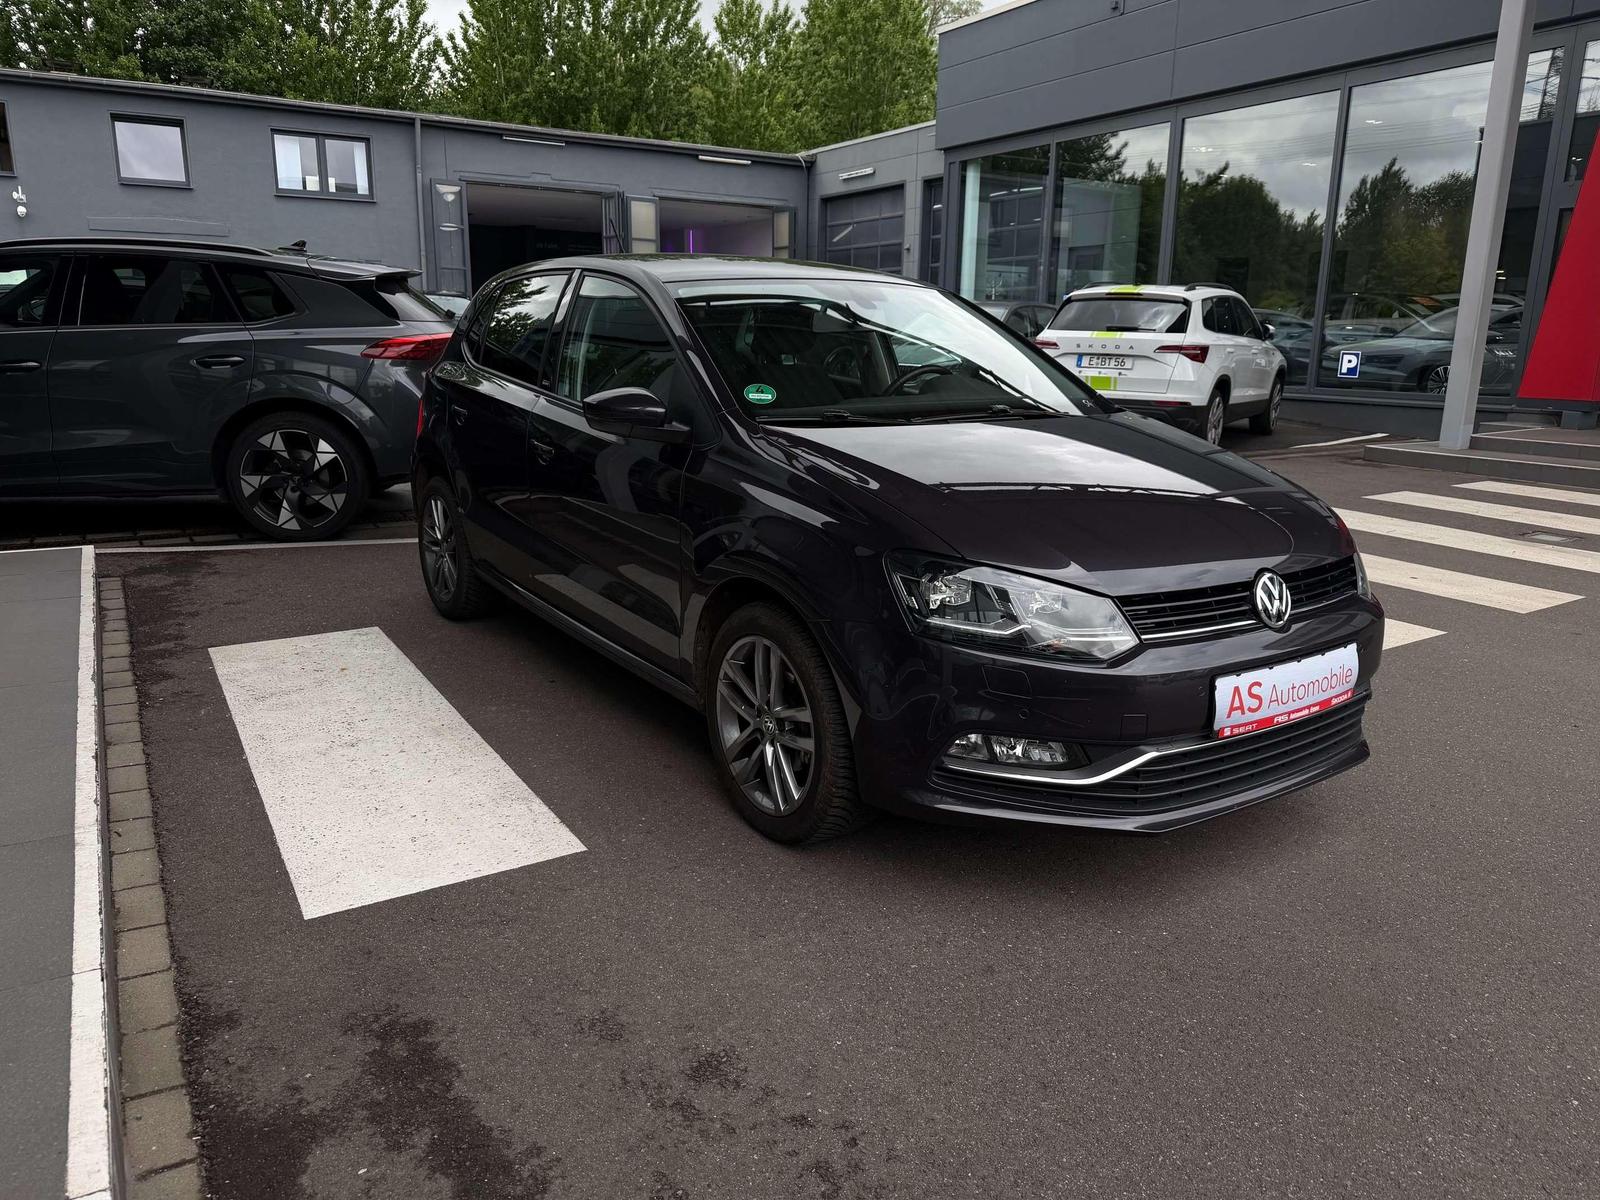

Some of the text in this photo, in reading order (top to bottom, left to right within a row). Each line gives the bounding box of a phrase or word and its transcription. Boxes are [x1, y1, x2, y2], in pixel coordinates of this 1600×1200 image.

[1341, 354, 1358, 374] P
[1226, 664, 1352, 719] AS Automobile
